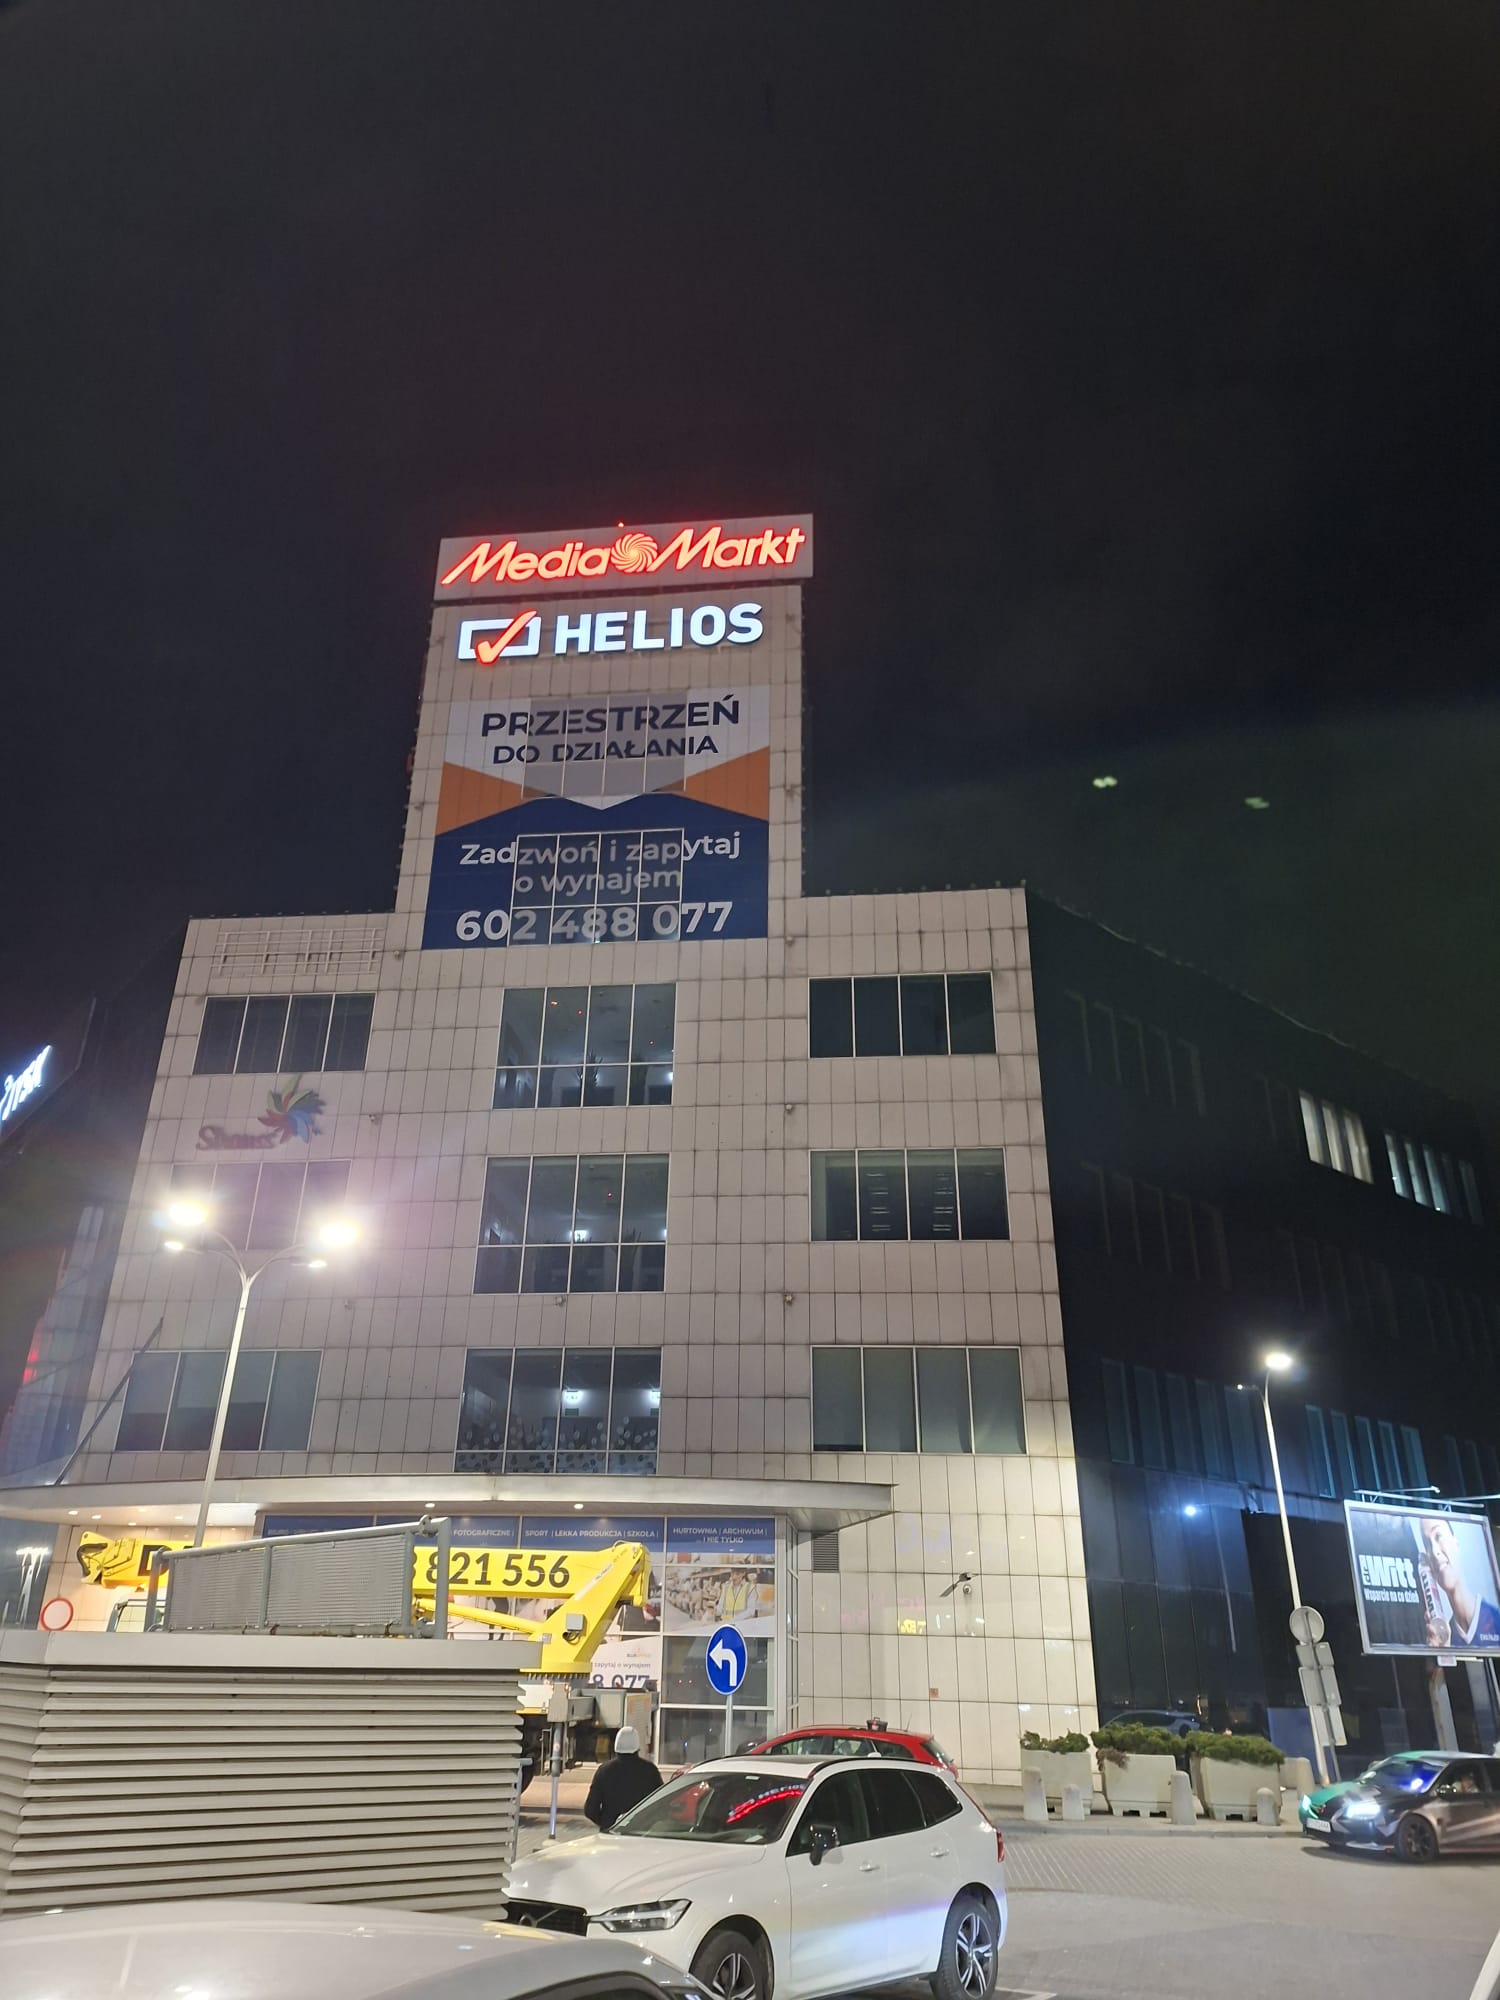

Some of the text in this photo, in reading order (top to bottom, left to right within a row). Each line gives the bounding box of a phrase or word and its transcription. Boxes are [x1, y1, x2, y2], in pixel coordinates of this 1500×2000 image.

[440, 526, 806, 586] Media Markt
[554, 602, 765, 655] HELIOS
[481, 694, 740, 737] PRZESTRZEŃ
[493, 735, 719, 764] DO DZIAŁANIA
[459, 831, 741, 866] Zadzwoń i zapytaj
[515, 866, 681, 897] o wynajem
[456, 901, 733, 941] 602 488 077
[453, 1529, 511, 1538] FOTOGRAFICZNE
[525, 1530, 655, 1538] SPORT LEKKA PRODUKCJA SZKOŁA
[673, 1527, 764, 1535] HURTOWNIA ARCHIWUM
[720, 1536, 744, 1544] TYLKO
[426, 1551, 492, 1586] 821
[502, 1553, 570, 1588] 556
